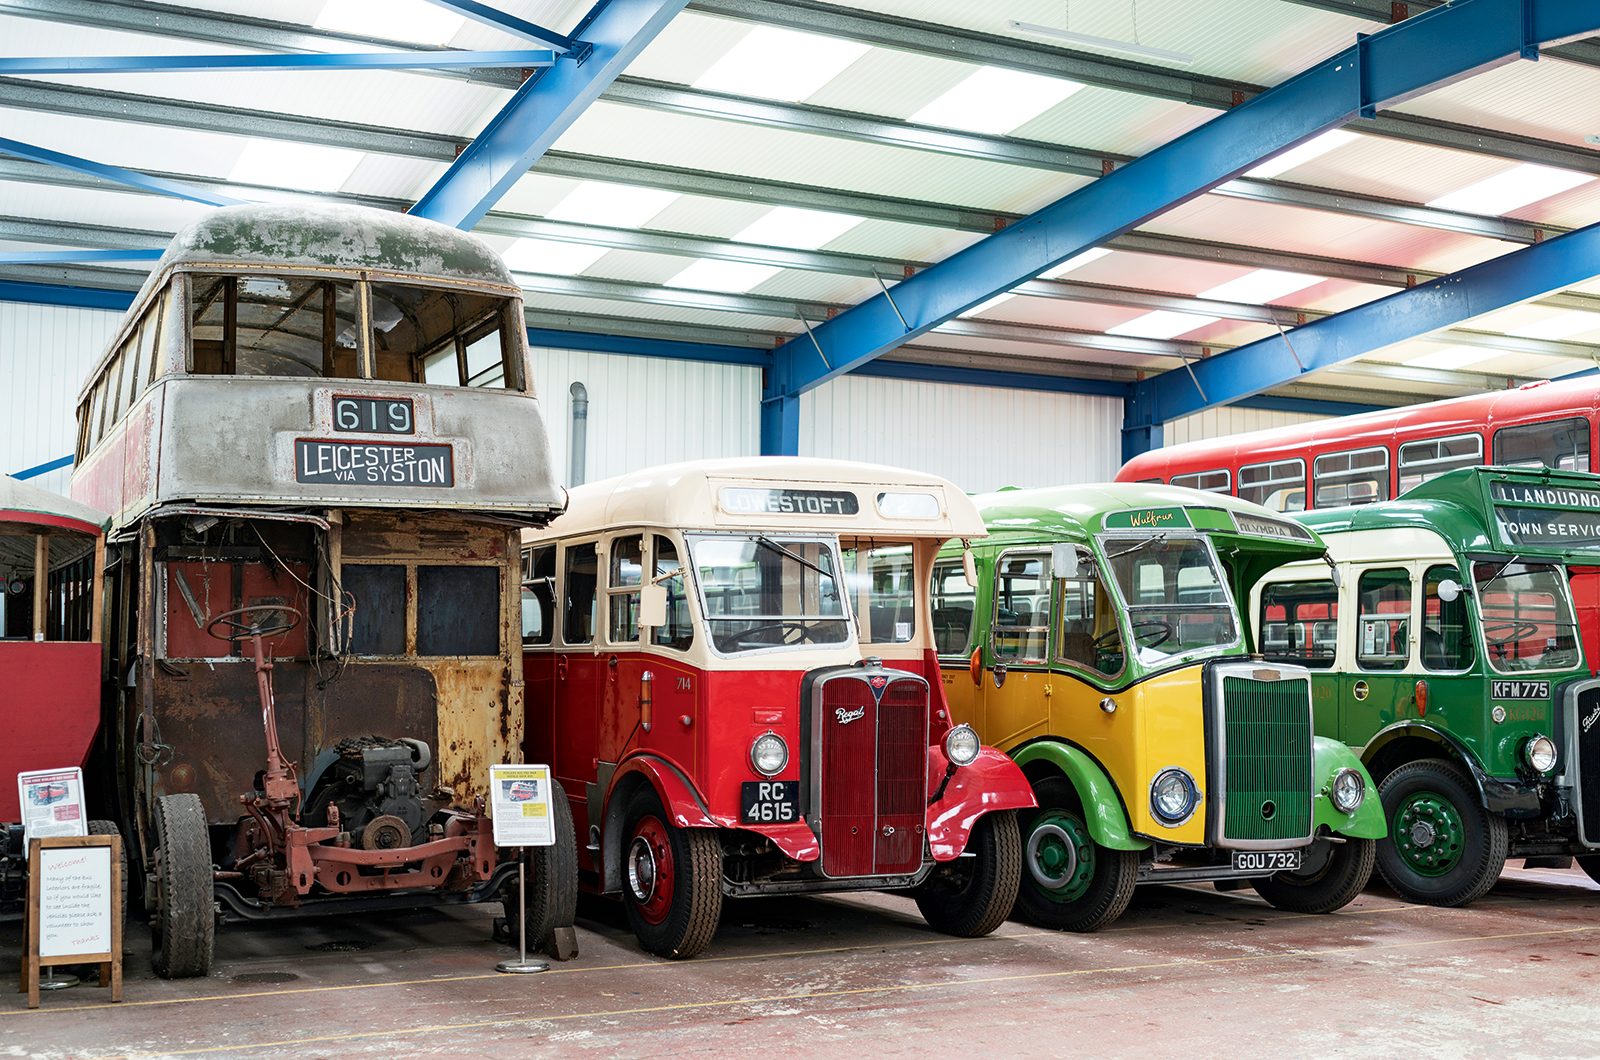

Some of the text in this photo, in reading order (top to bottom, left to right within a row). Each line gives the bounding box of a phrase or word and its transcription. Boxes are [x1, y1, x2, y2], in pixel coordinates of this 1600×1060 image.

[336, 400, 411, 432] 619
[303, 444, 415, 476] LEICESTER
[334, 456, 445, 483] VIA SYSTON
[725, 493, 844, 514] LOWESTOFT
[1500, 487, 1600, 508] LLANDUDNO
[1130, 510, 1174, 527] Wulfrun
[1240, 523, 1286, 536] OLYMPIA
[1500, 521, 1542, 535] TOWN
[676, 677, 691, 690] 714
[1494, 682, 1548, 697] KFM 775
[836, 706, 864, 724] Regal
[1509, 707, 1544, 721] KG126
[758, 782, 784, 800] RC
[748, 802, 792, 820] 4615
[1238, 853, 1294, 868] GOU 732
